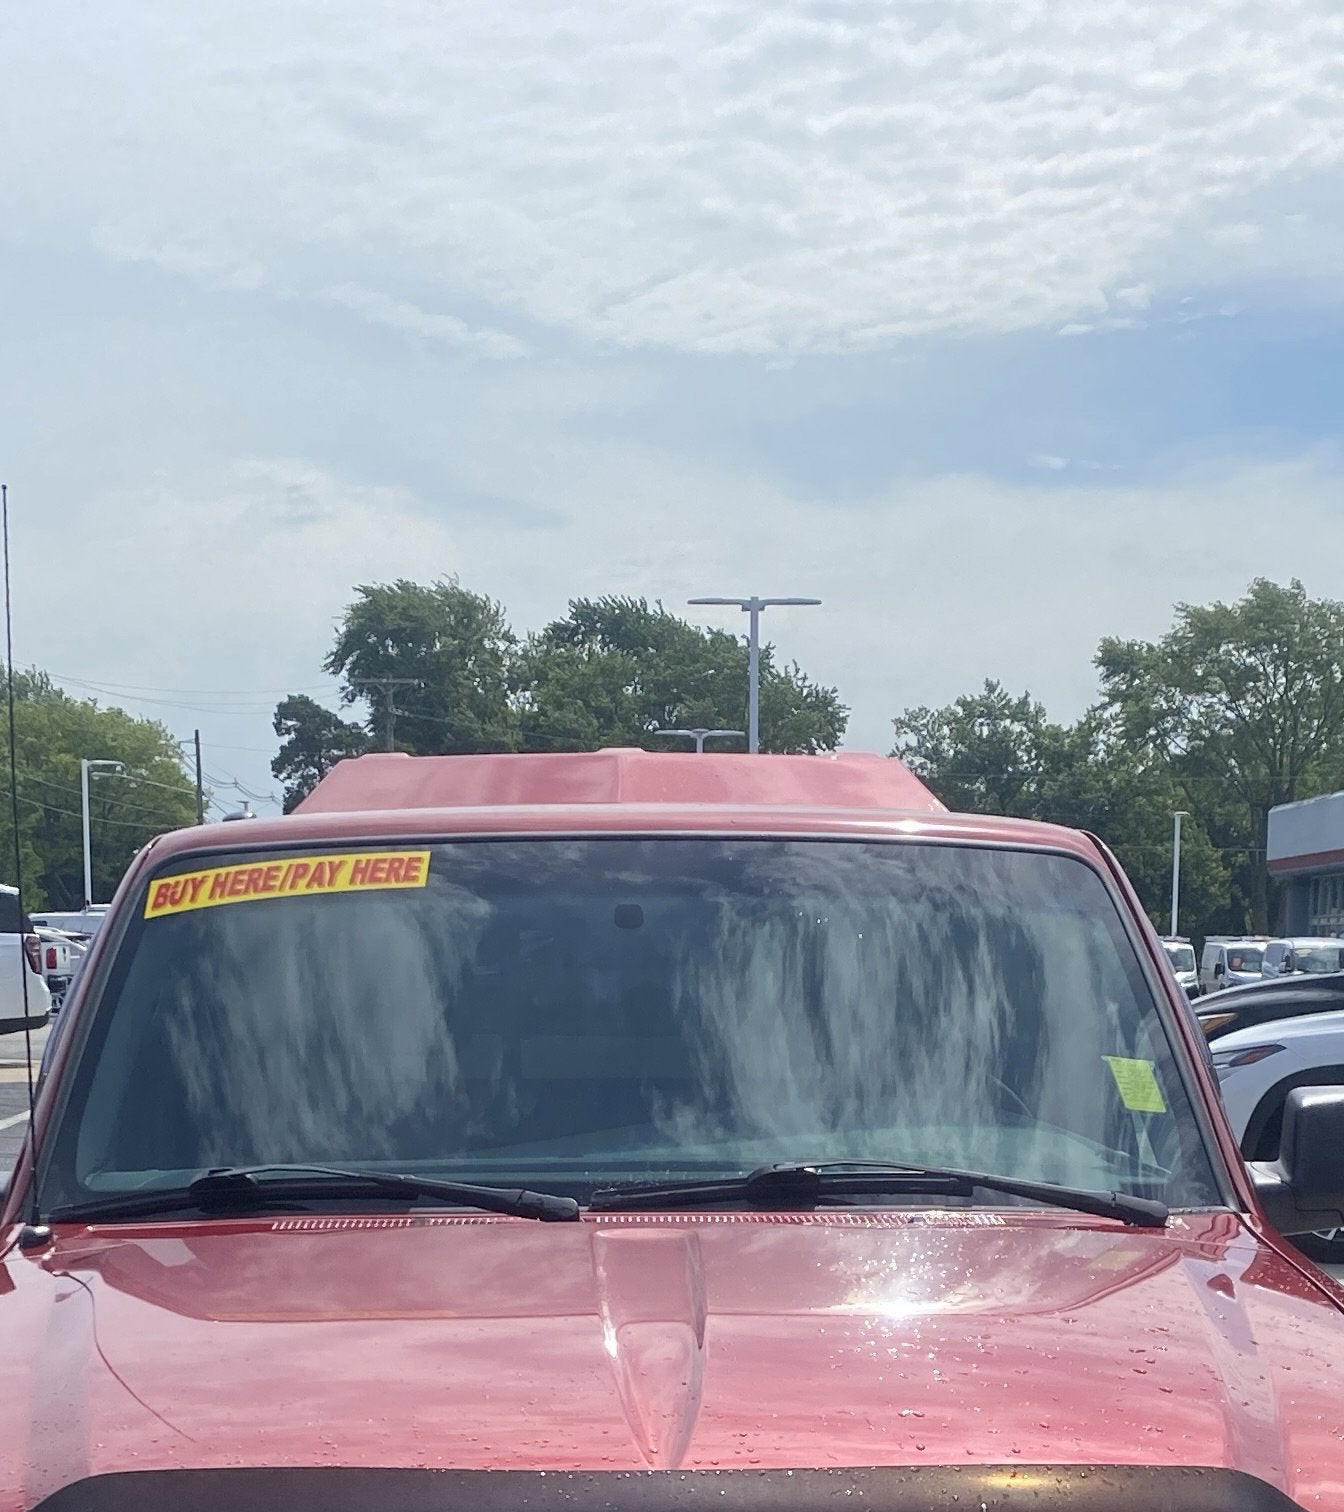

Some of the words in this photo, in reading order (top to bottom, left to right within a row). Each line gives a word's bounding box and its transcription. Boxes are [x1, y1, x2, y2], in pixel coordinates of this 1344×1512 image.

[152, 875, 210, 911] BUY
[208, 860, 348, 900] HERE/PAY
[348, 856, 425, 886] HERE
